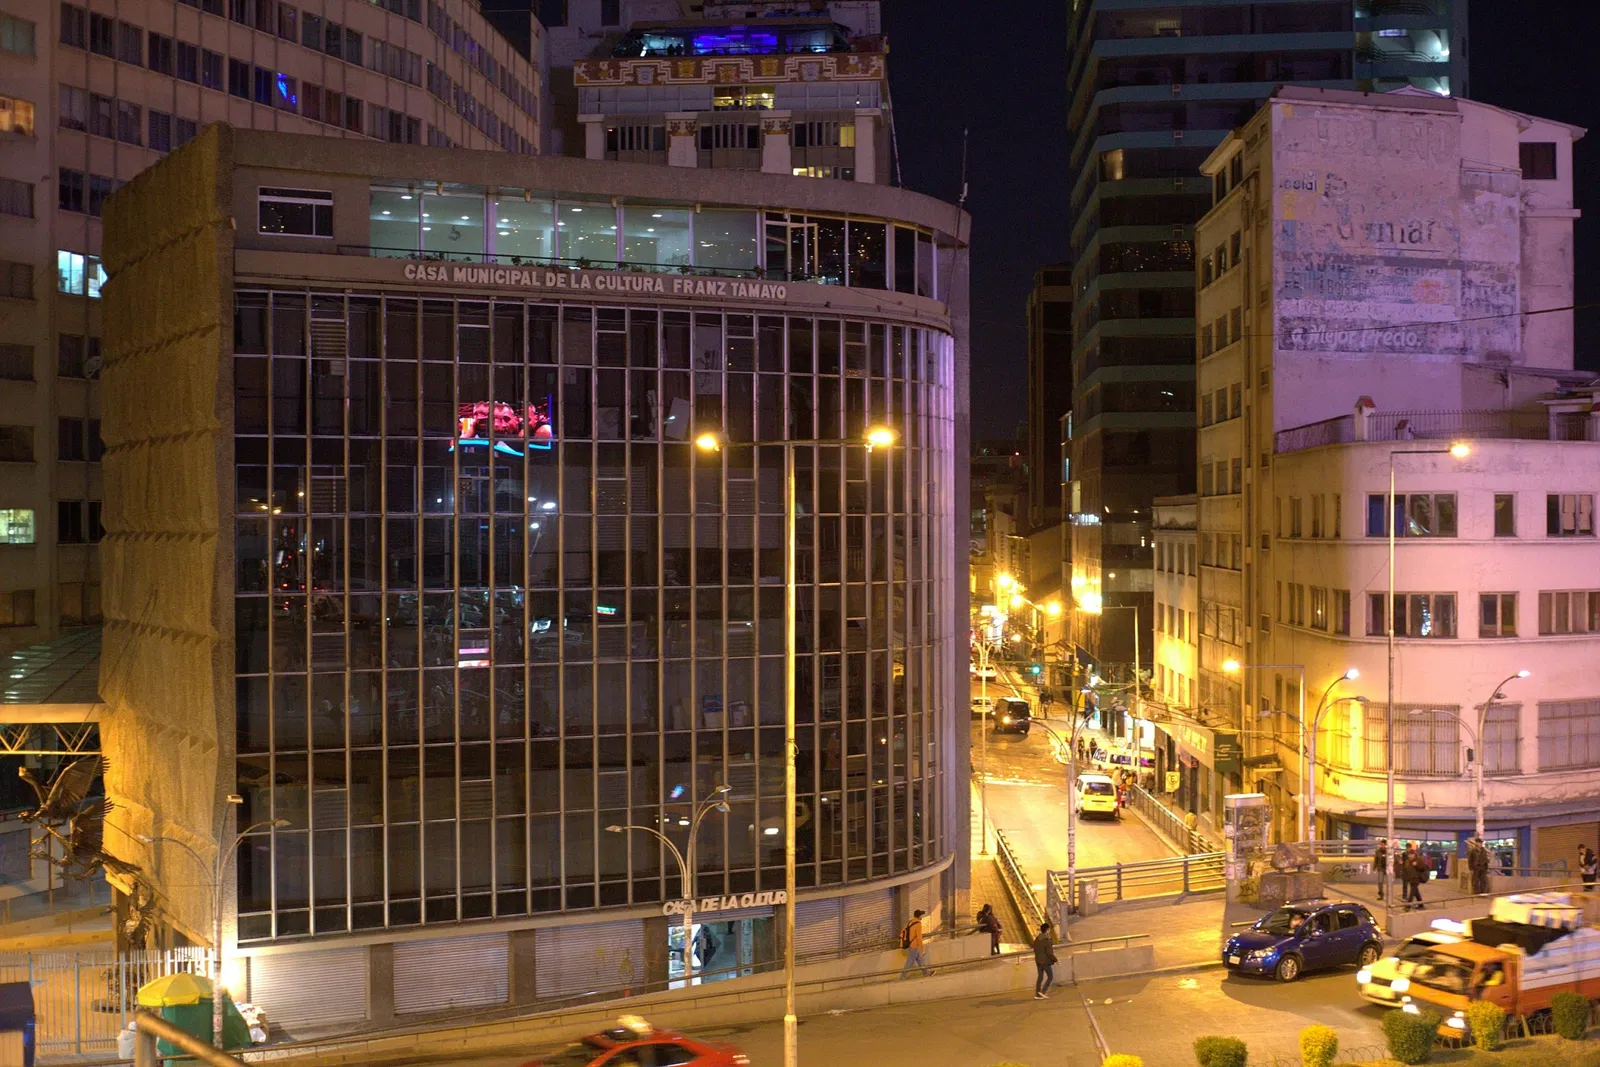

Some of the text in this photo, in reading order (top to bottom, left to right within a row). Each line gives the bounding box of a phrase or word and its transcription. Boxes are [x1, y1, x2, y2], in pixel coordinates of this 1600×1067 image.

[404, 263, 787, 300] CASA MUNICIPAL DE LA CULTURA FRANZ TAMAYO
[701, 897, 720, 912] DE
[721, 894, 739, 910] LA
[741, 890, 788, 908] CULTUR
